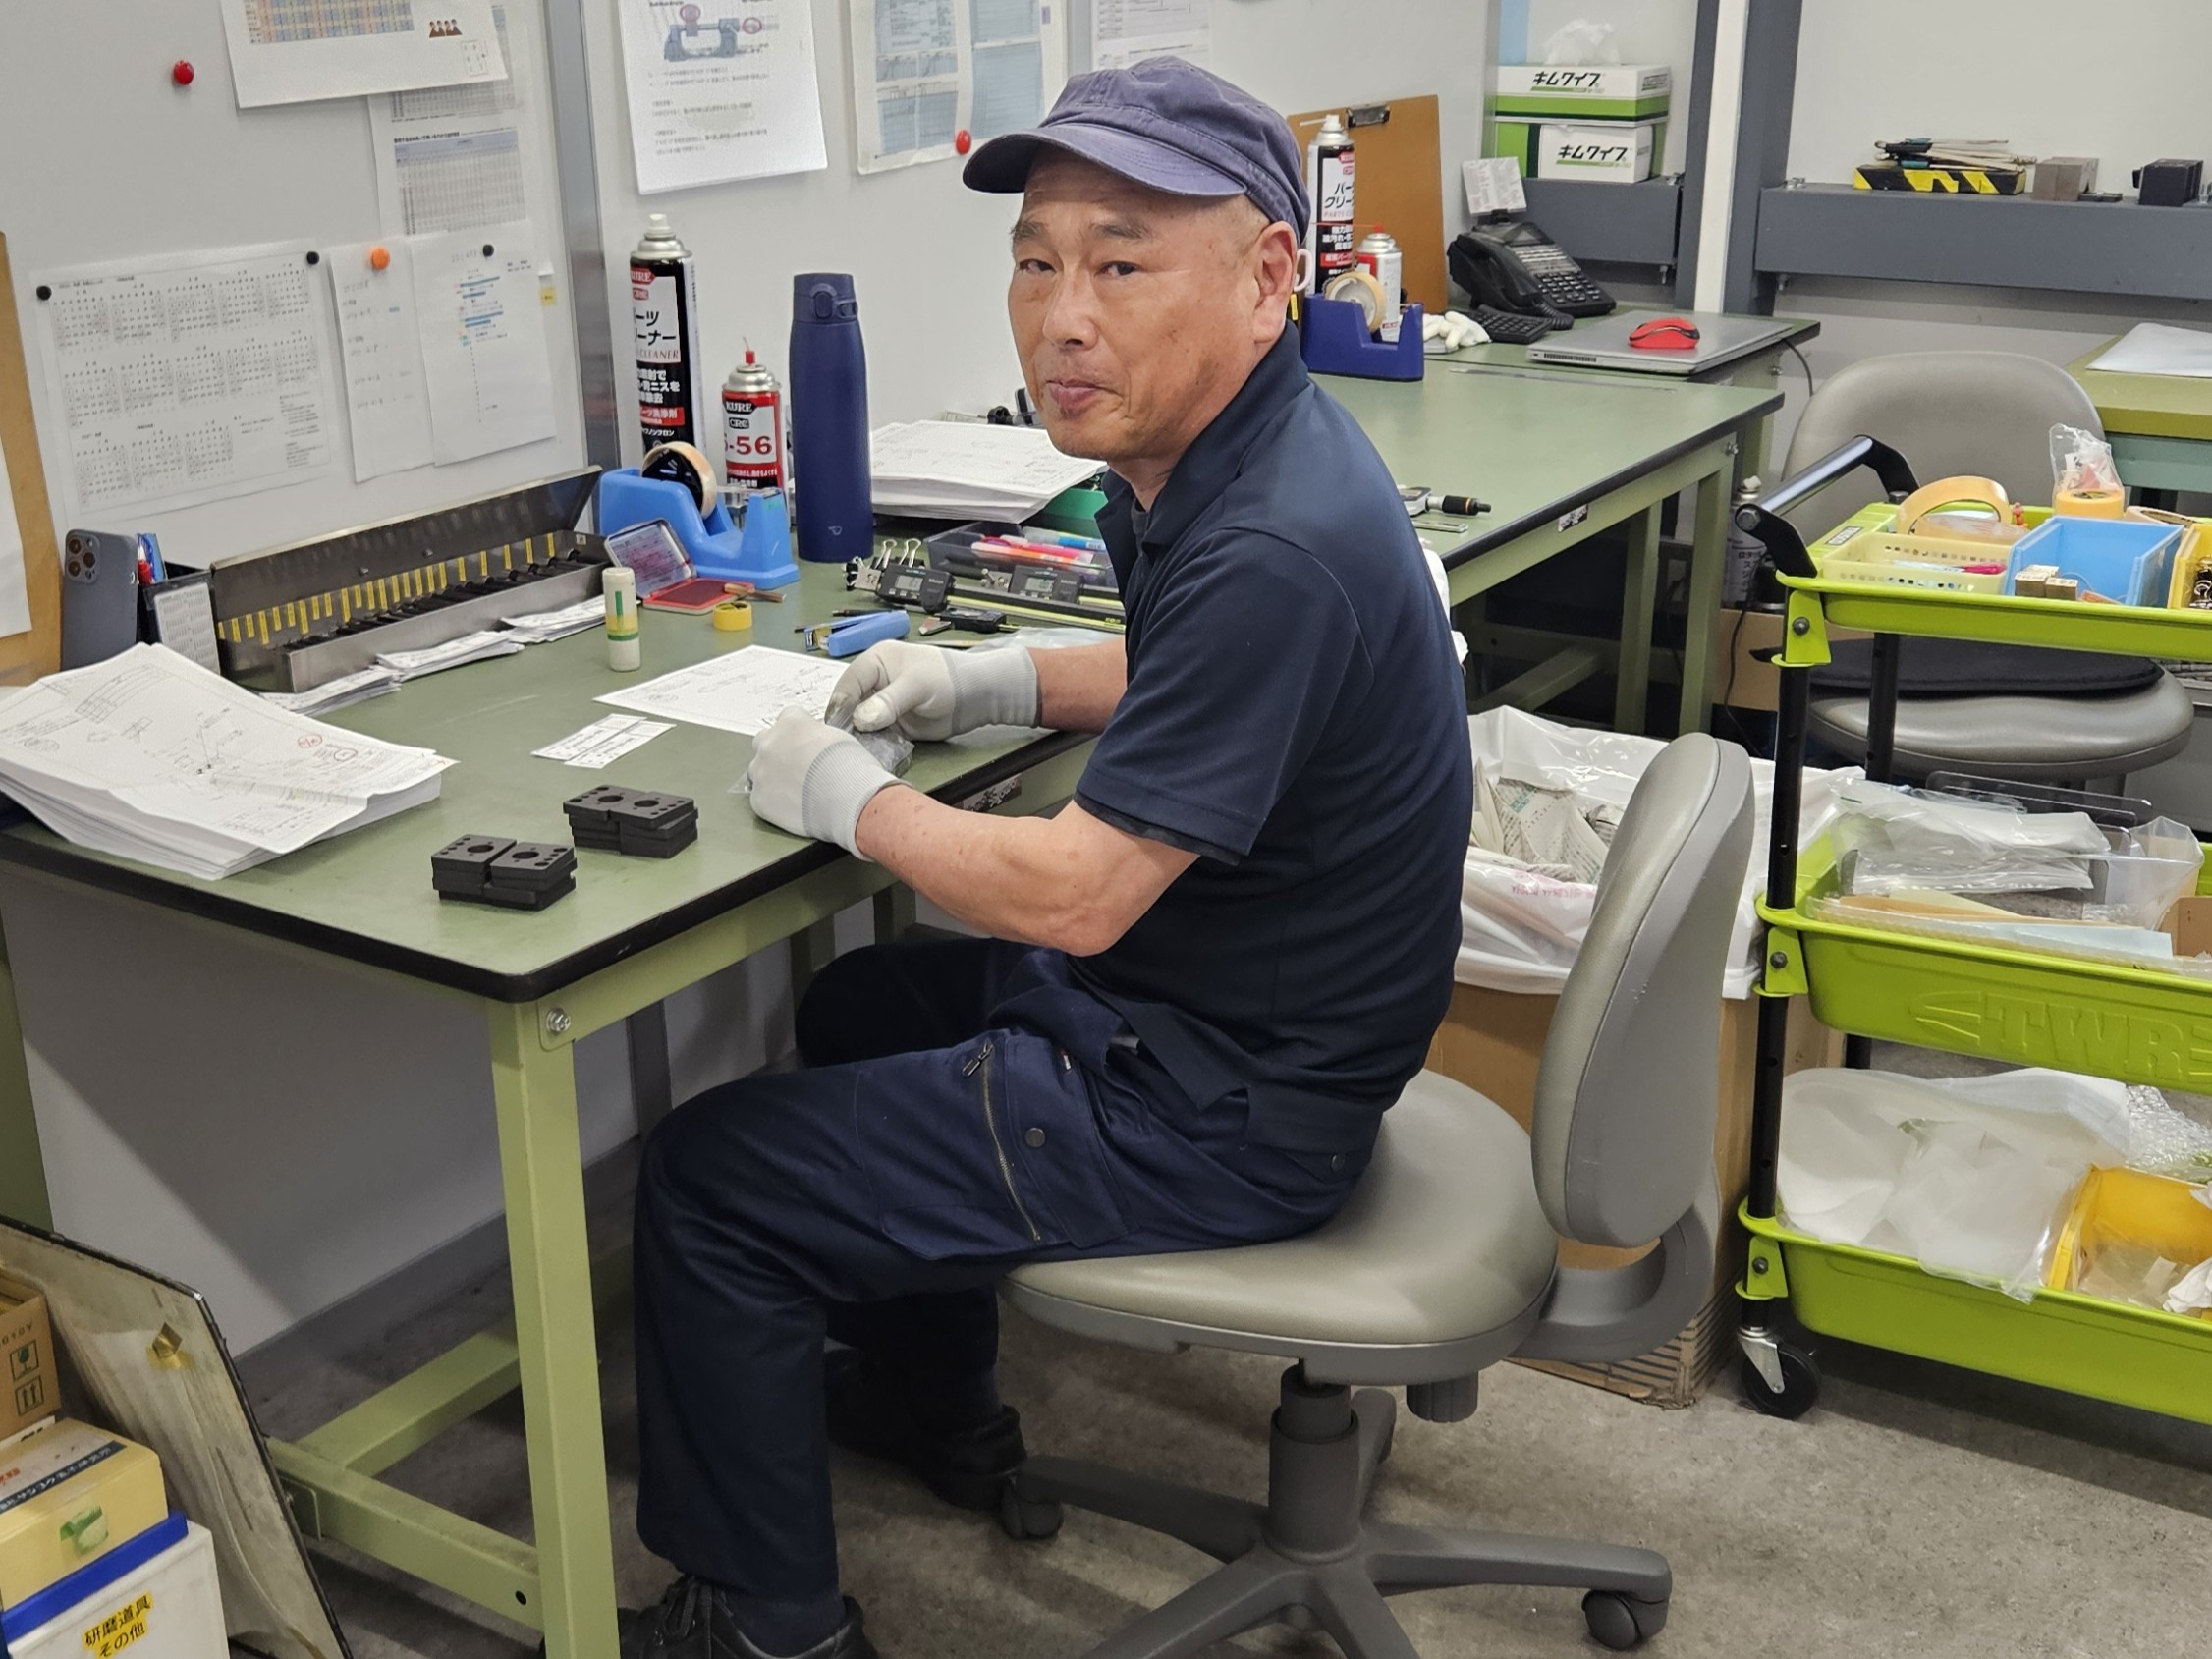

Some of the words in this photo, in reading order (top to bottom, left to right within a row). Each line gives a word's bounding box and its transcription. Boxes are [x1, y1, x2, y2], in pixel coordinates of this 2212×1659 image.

[1334, 182, 1355, 194] パー
[1324, 196, 1354, 209] クリー
[633, 307, 659, 327] ーツ
[726, 401, 753, 413] KURE
[730, 418, 748, 428] CRC
[84, 1594, 151, 1648] 研磨道具
[99, 1621, 146, 1658] その他
